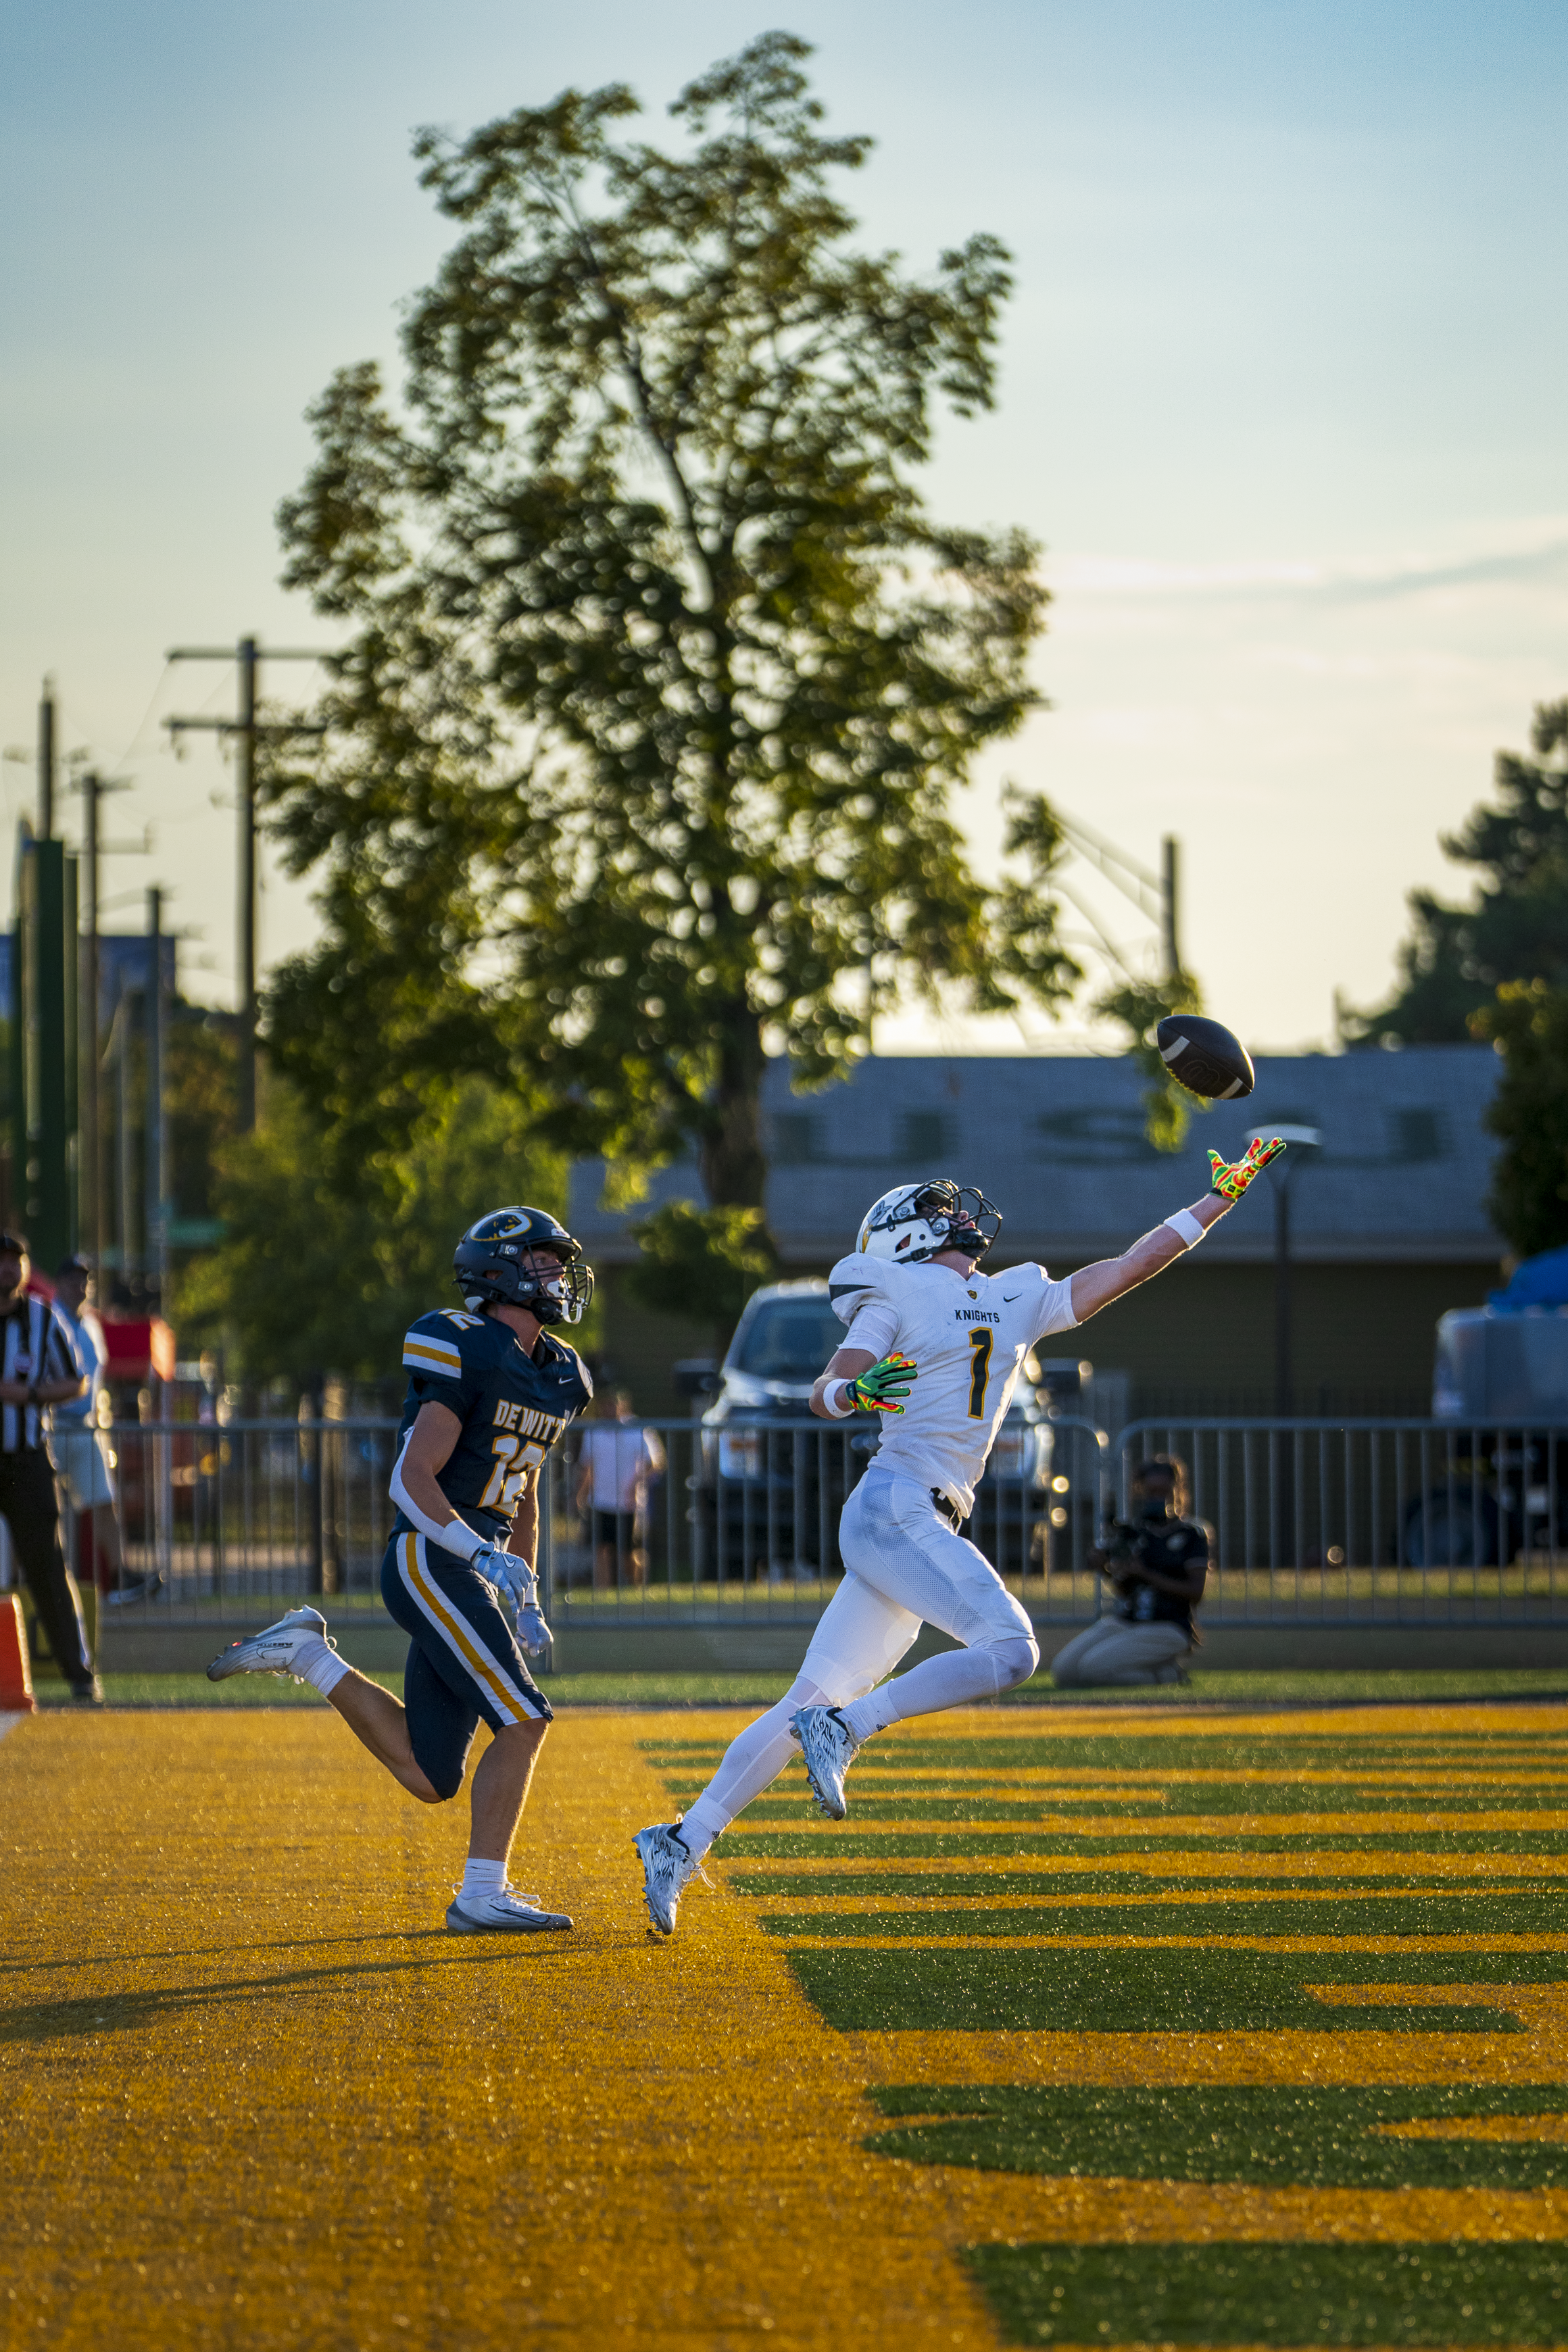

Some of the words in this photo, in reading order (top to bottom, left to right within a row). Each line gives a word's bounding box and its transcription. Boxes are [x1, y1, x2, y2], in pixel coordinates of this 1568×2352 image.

[439, 1308, 485, 1331] 12
[954, 1309, 1000, 1323] KNIGHTS
[968, 1327, 994, 1420] 1
[492, 1398, 566, 1444] DEWITT
[476, 1434, 545, 1518] 12
